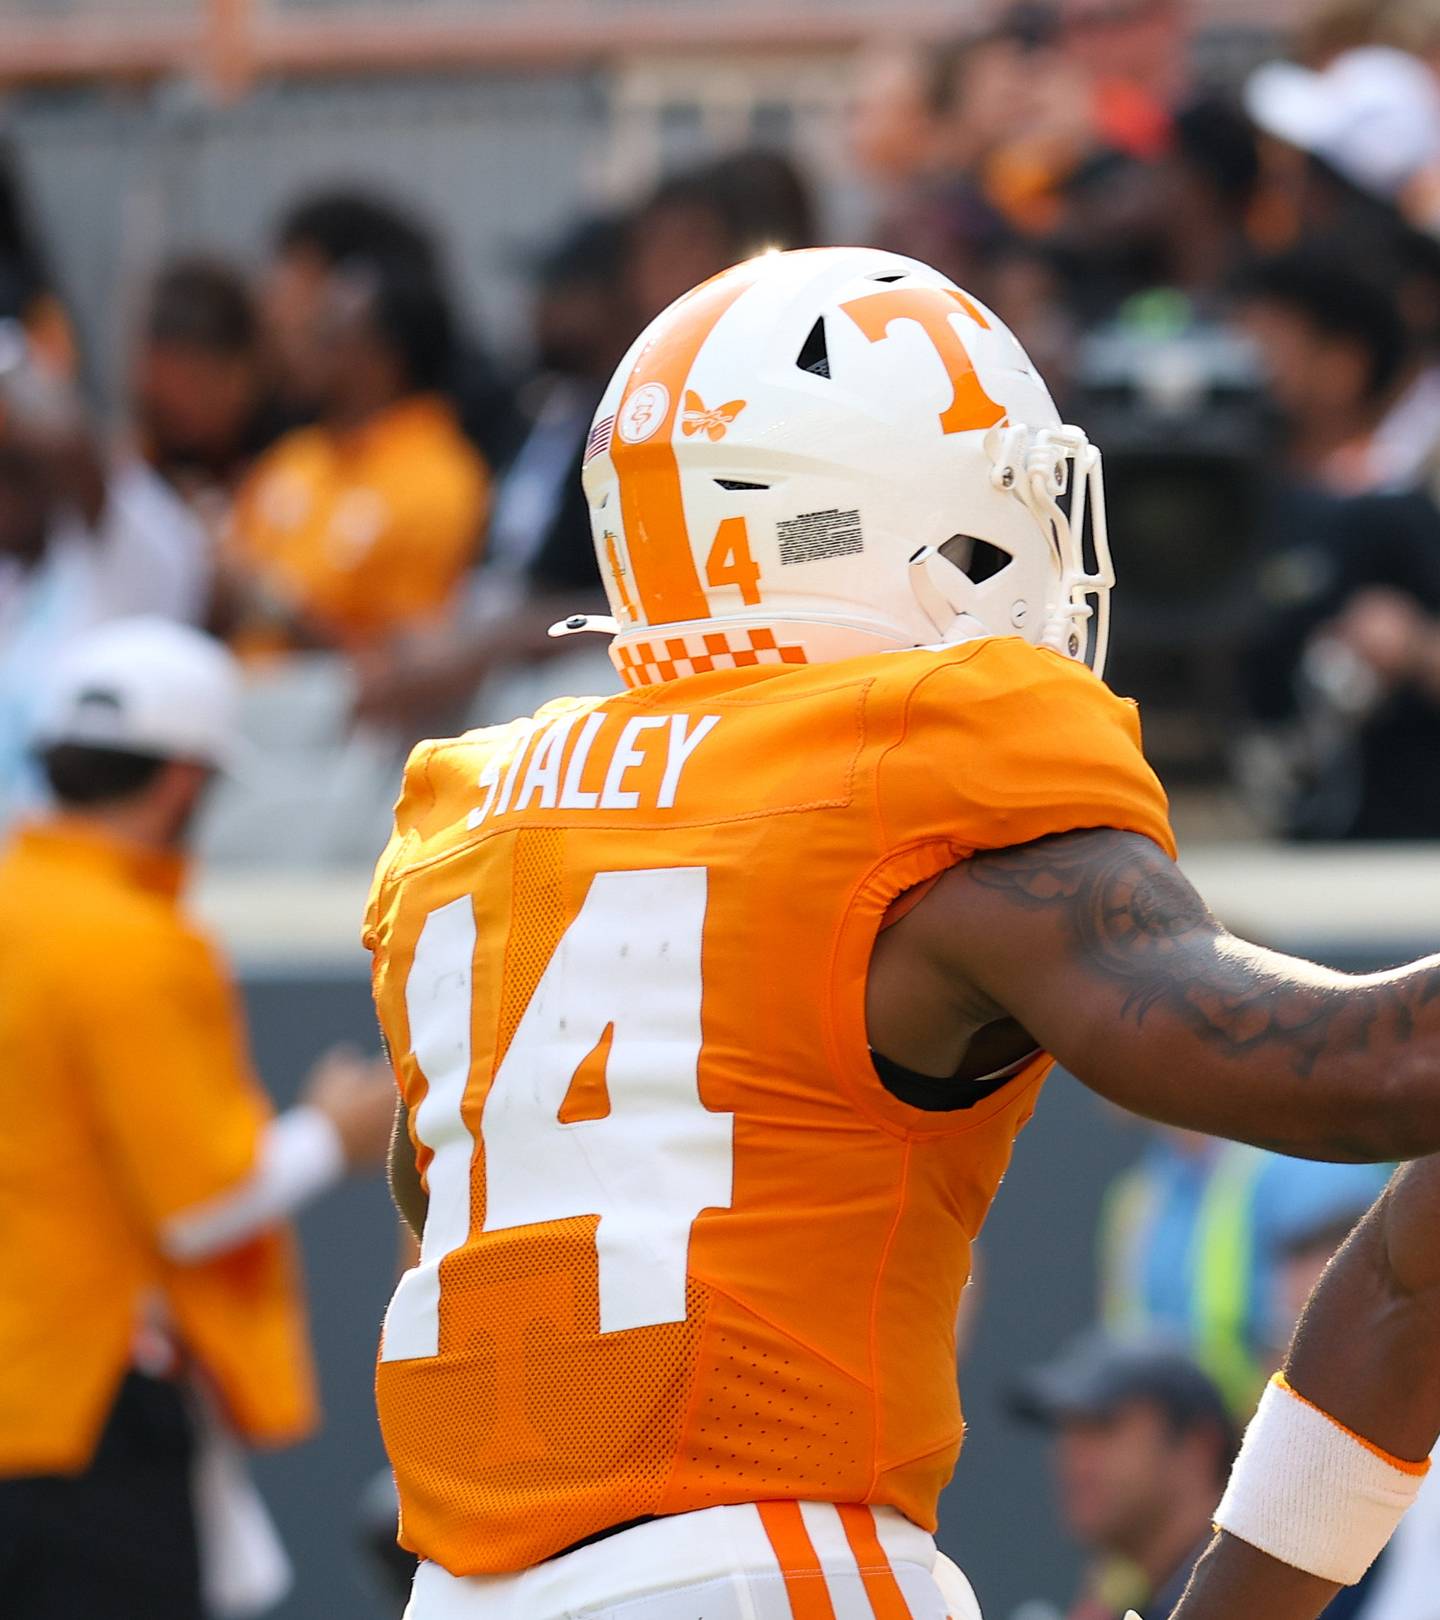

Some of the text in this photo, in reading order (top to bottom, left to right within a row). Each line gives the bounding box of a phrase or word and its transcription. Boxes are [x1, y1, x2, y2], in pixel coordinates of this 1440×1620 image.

[838, 287, 1010, 435] T
[706, 516, 762, 607] 4
[466, 711, 721, 831] STALEY
[380, 866, 735, 1363] 14
